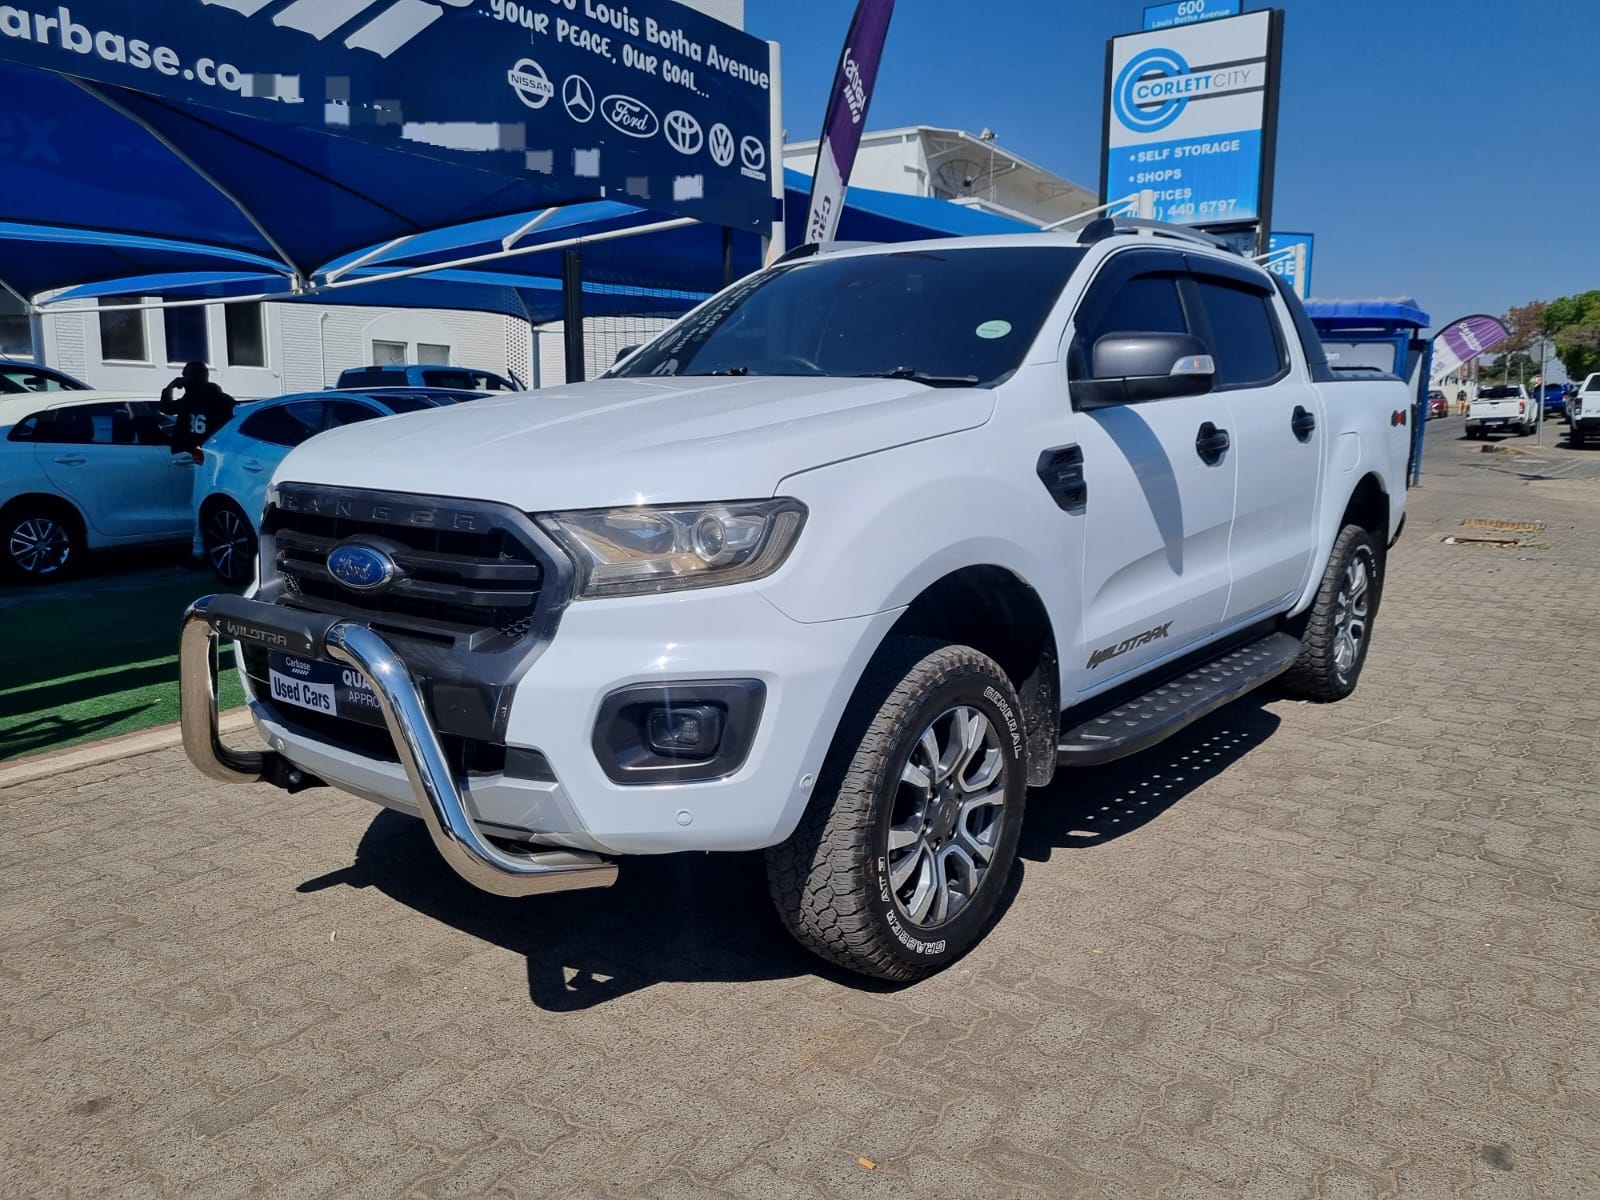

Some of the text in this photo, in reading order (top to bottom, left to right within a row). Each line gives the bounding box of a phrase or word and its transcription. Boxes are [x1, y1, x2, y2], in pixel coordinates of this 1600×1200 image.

[1177, 0, 1205, 16] 600
[1199, 9, 1231, 21] Avenue
[584, 0, 769, 89] Louis Botha Avenue
[622, 43, 657, 75] OUR
[511, 74, 551, 94] NISSAN
[611, 100, 649, 132] Ford
[1137, 139, 1241, 163] SELF STORAGE
[1136, 168, 1182, 184] SHOPS
[1153, 187, 1192, 202] FICES
[1167, 203, 1195, 217] 440
[1199, 198, 1237, 214] 6797
[336, 553, 371, 581] Ford
[1086, 620, 1175, 670] WILDTRAK
[342, 669, 373, 691] QUA
[273, 676, 330, 710] Used Cars
[348, 690, 381, 709] APPRO
[983, 686, 1020, 759] GENERAL
